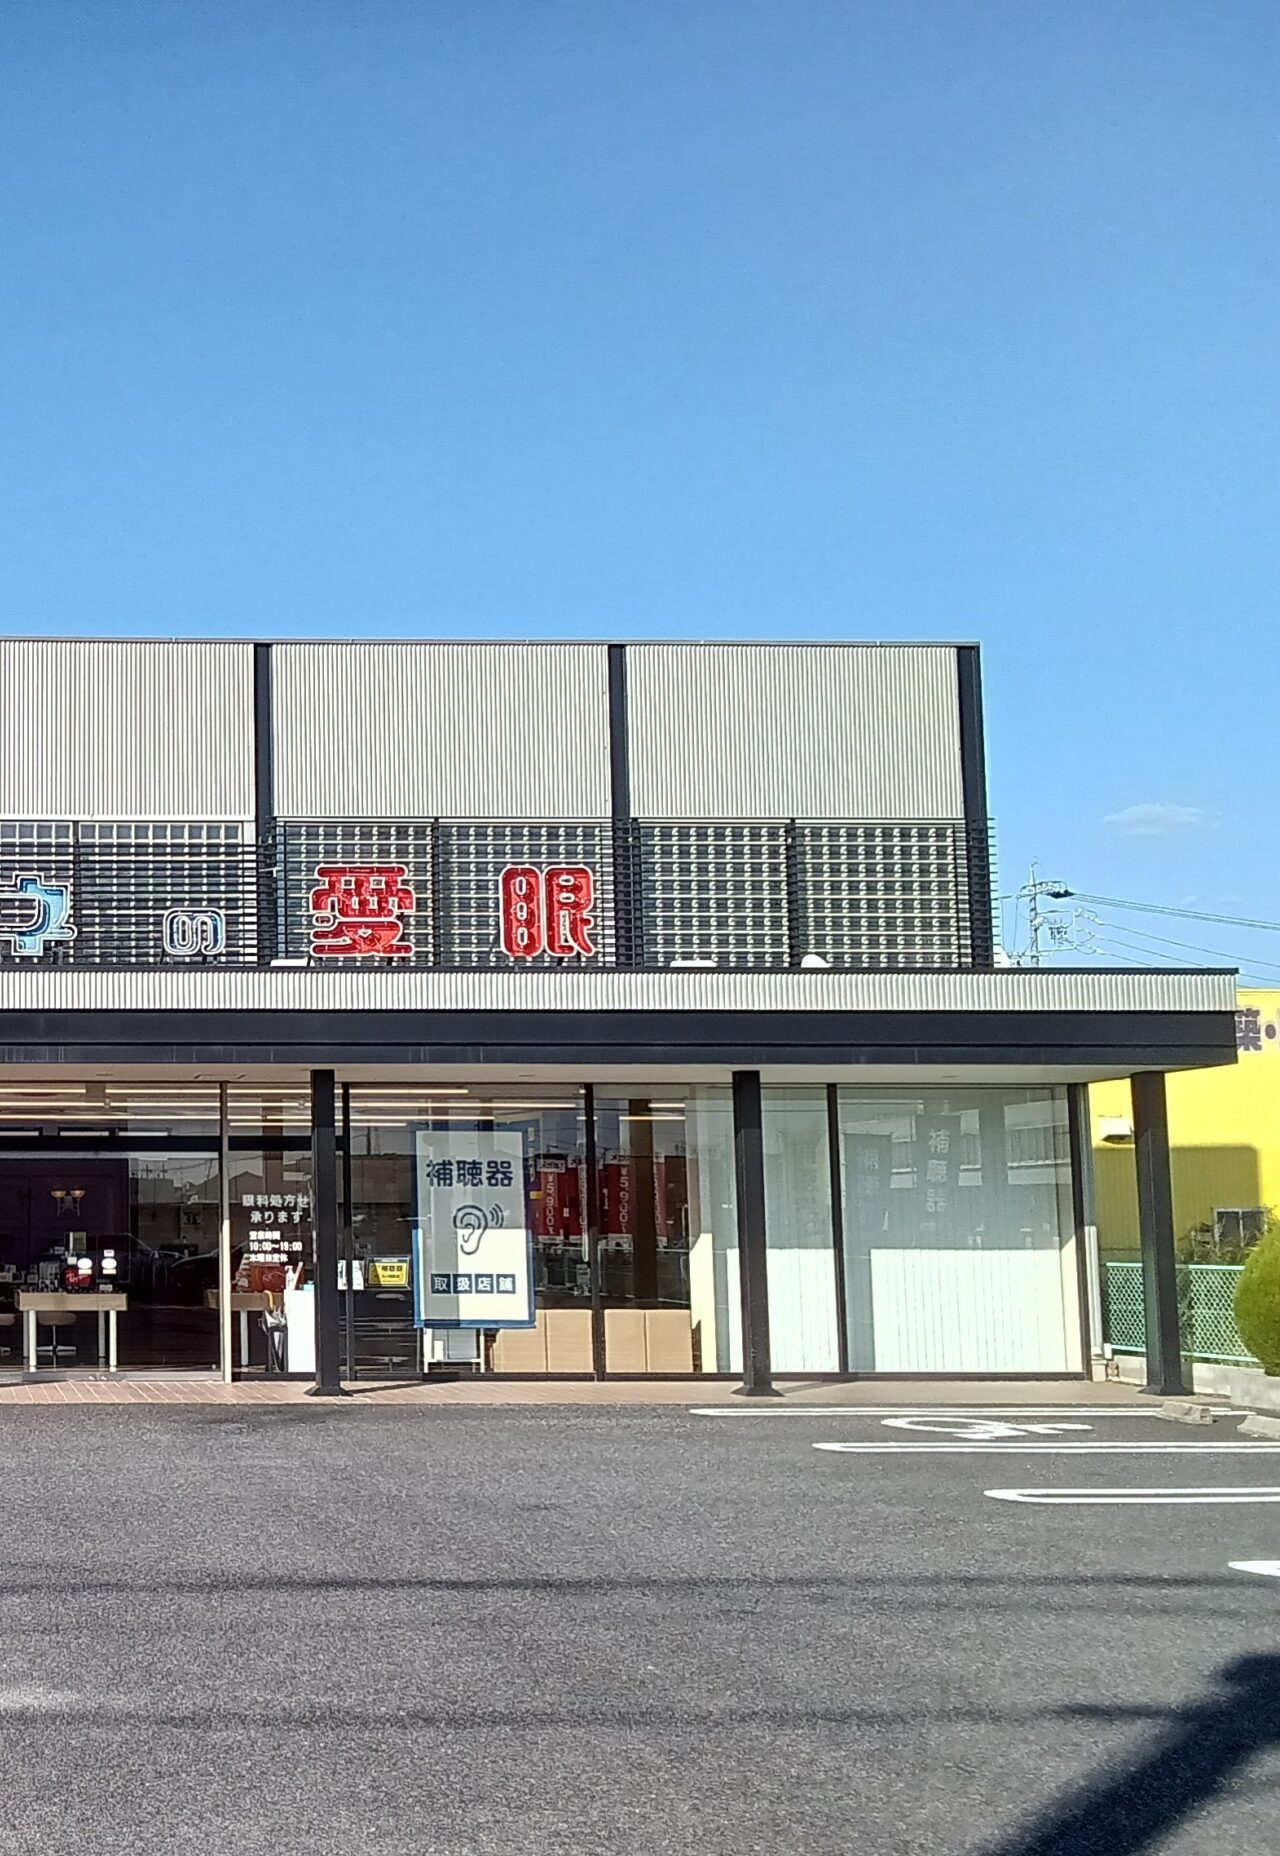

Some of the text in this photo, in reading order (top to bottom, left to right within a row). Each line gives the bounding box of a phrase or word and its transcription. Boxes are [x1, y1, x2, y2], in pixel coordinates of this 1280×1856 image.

[426, 1159, 513, 1187] 補聴器
[250, 1210, 303, 1224] 承ります
[432, 1274, 515, 1293] 取扱店舗
